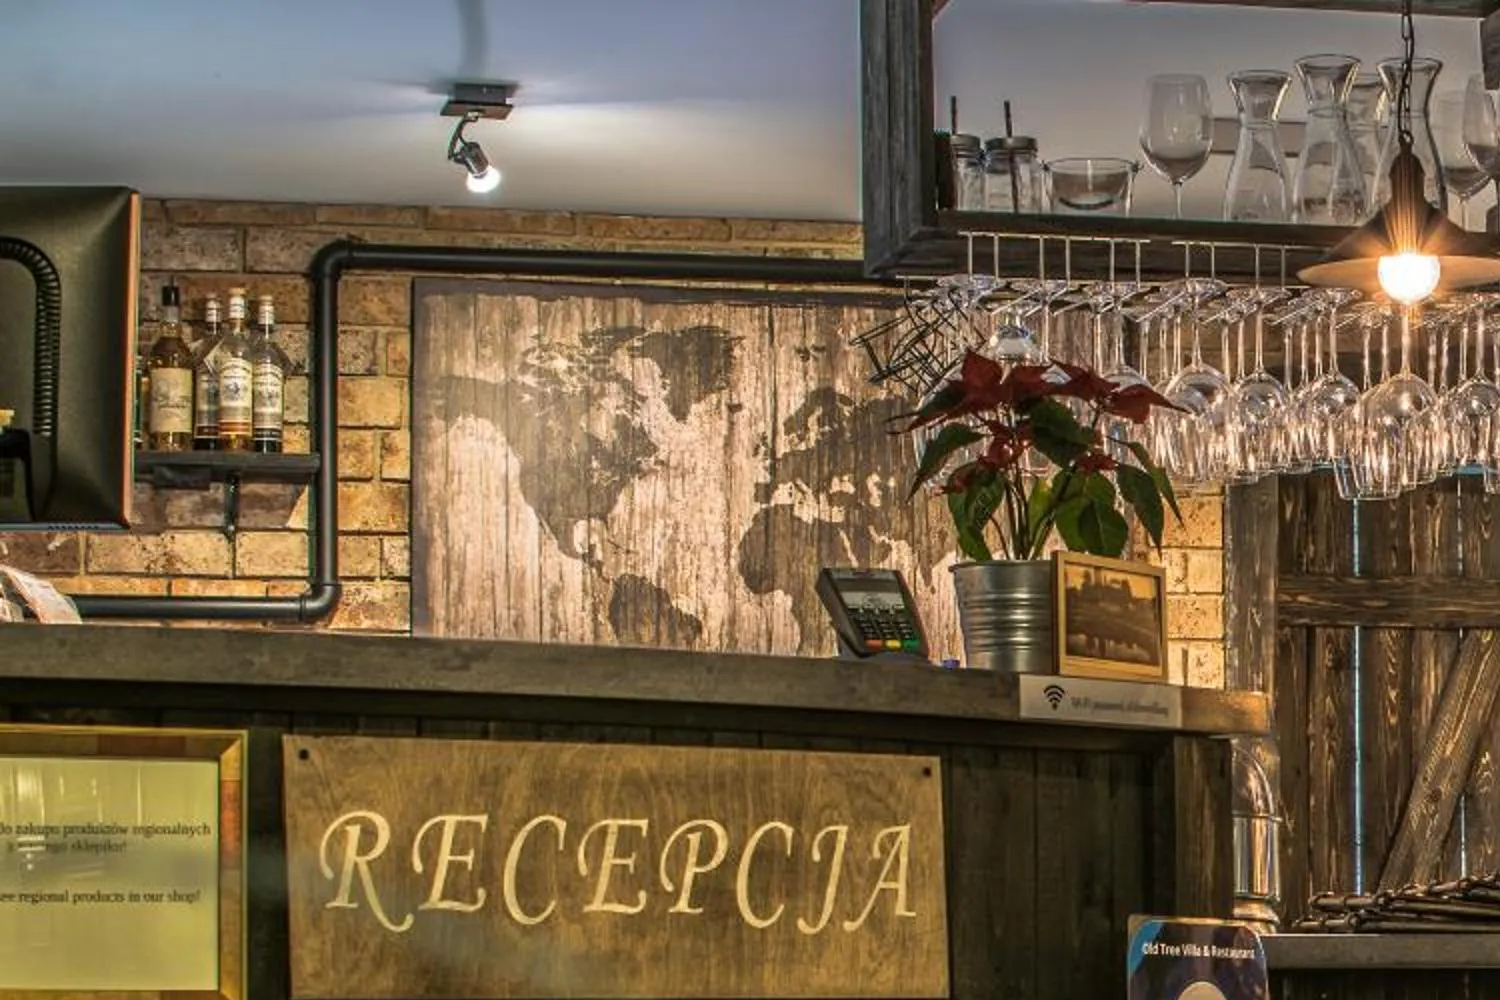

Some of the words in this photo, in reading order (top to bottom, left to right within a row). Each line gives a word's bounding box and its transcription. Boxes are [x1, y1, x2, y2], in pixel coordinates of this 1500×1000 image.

[132, 822, 212, 839] regionalnych
[319, 809, 918, 933] RECEPCJA
[19, 889, 70, 905] regional
[73, 889, 125, 905] products
[129, 889, 140, 902] in
[143, 891, 164, 903] our
[1142, 942, 1159, 955] Old
[1160, 943, 1180, 957] Tree
[1212, 945, 1255, 959] Restaurant
